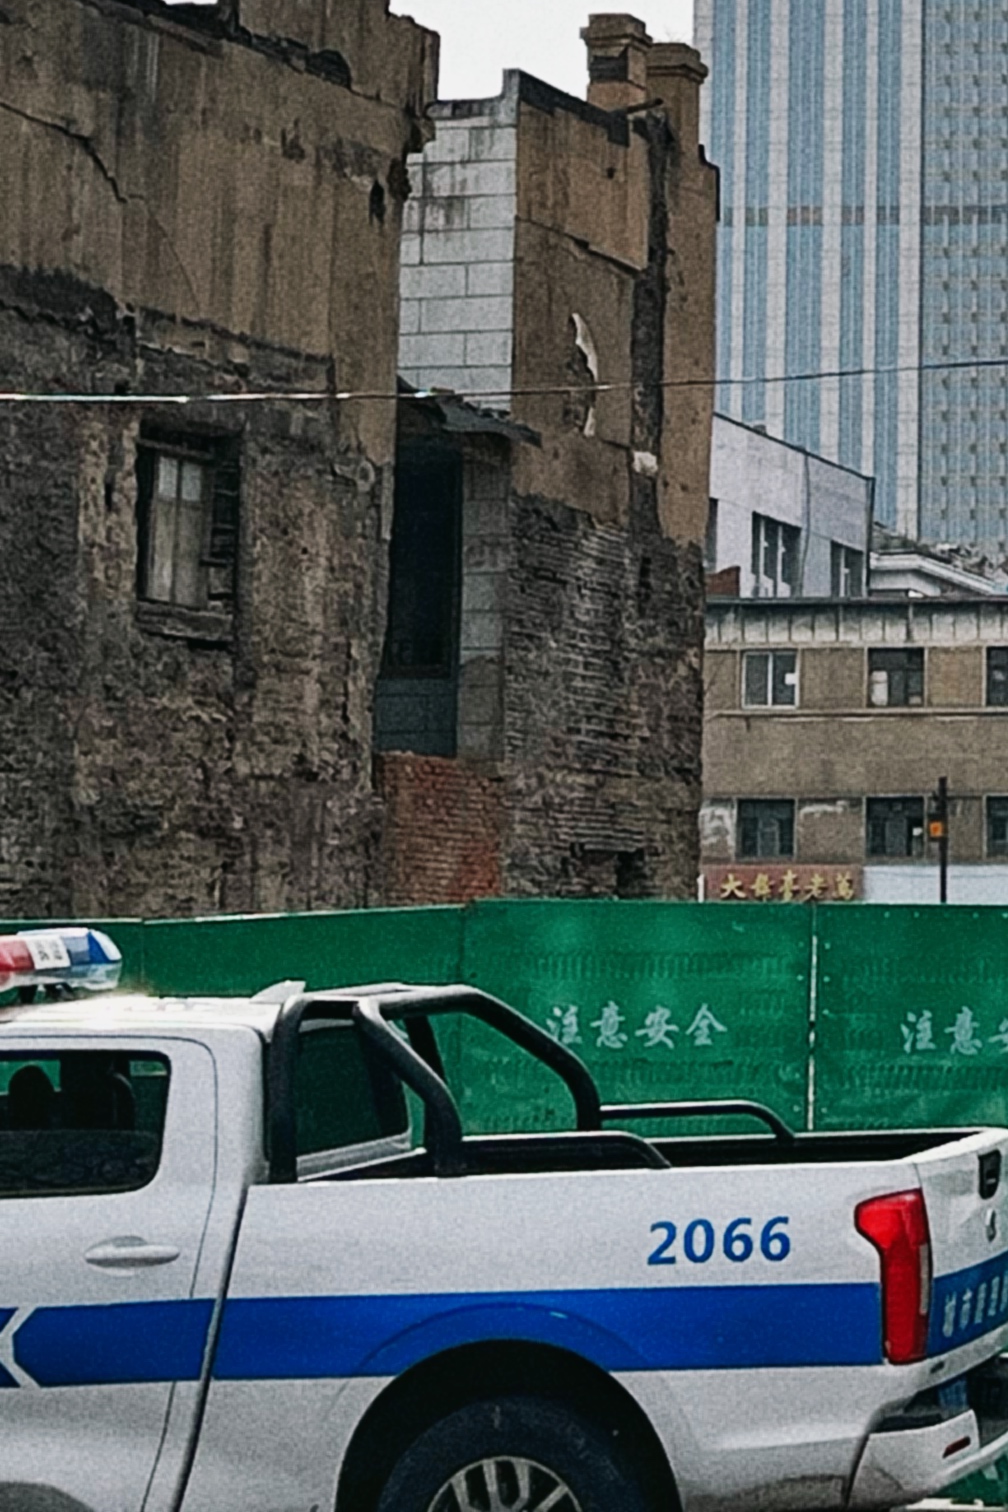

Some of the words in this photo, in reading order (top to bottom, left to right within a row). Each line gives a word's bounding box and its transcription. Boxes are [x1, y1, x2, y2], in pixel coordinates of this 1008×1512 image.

[546, 1000, 728, 1049] 注意安全
[647, 1216, 791, 1266] 2066
